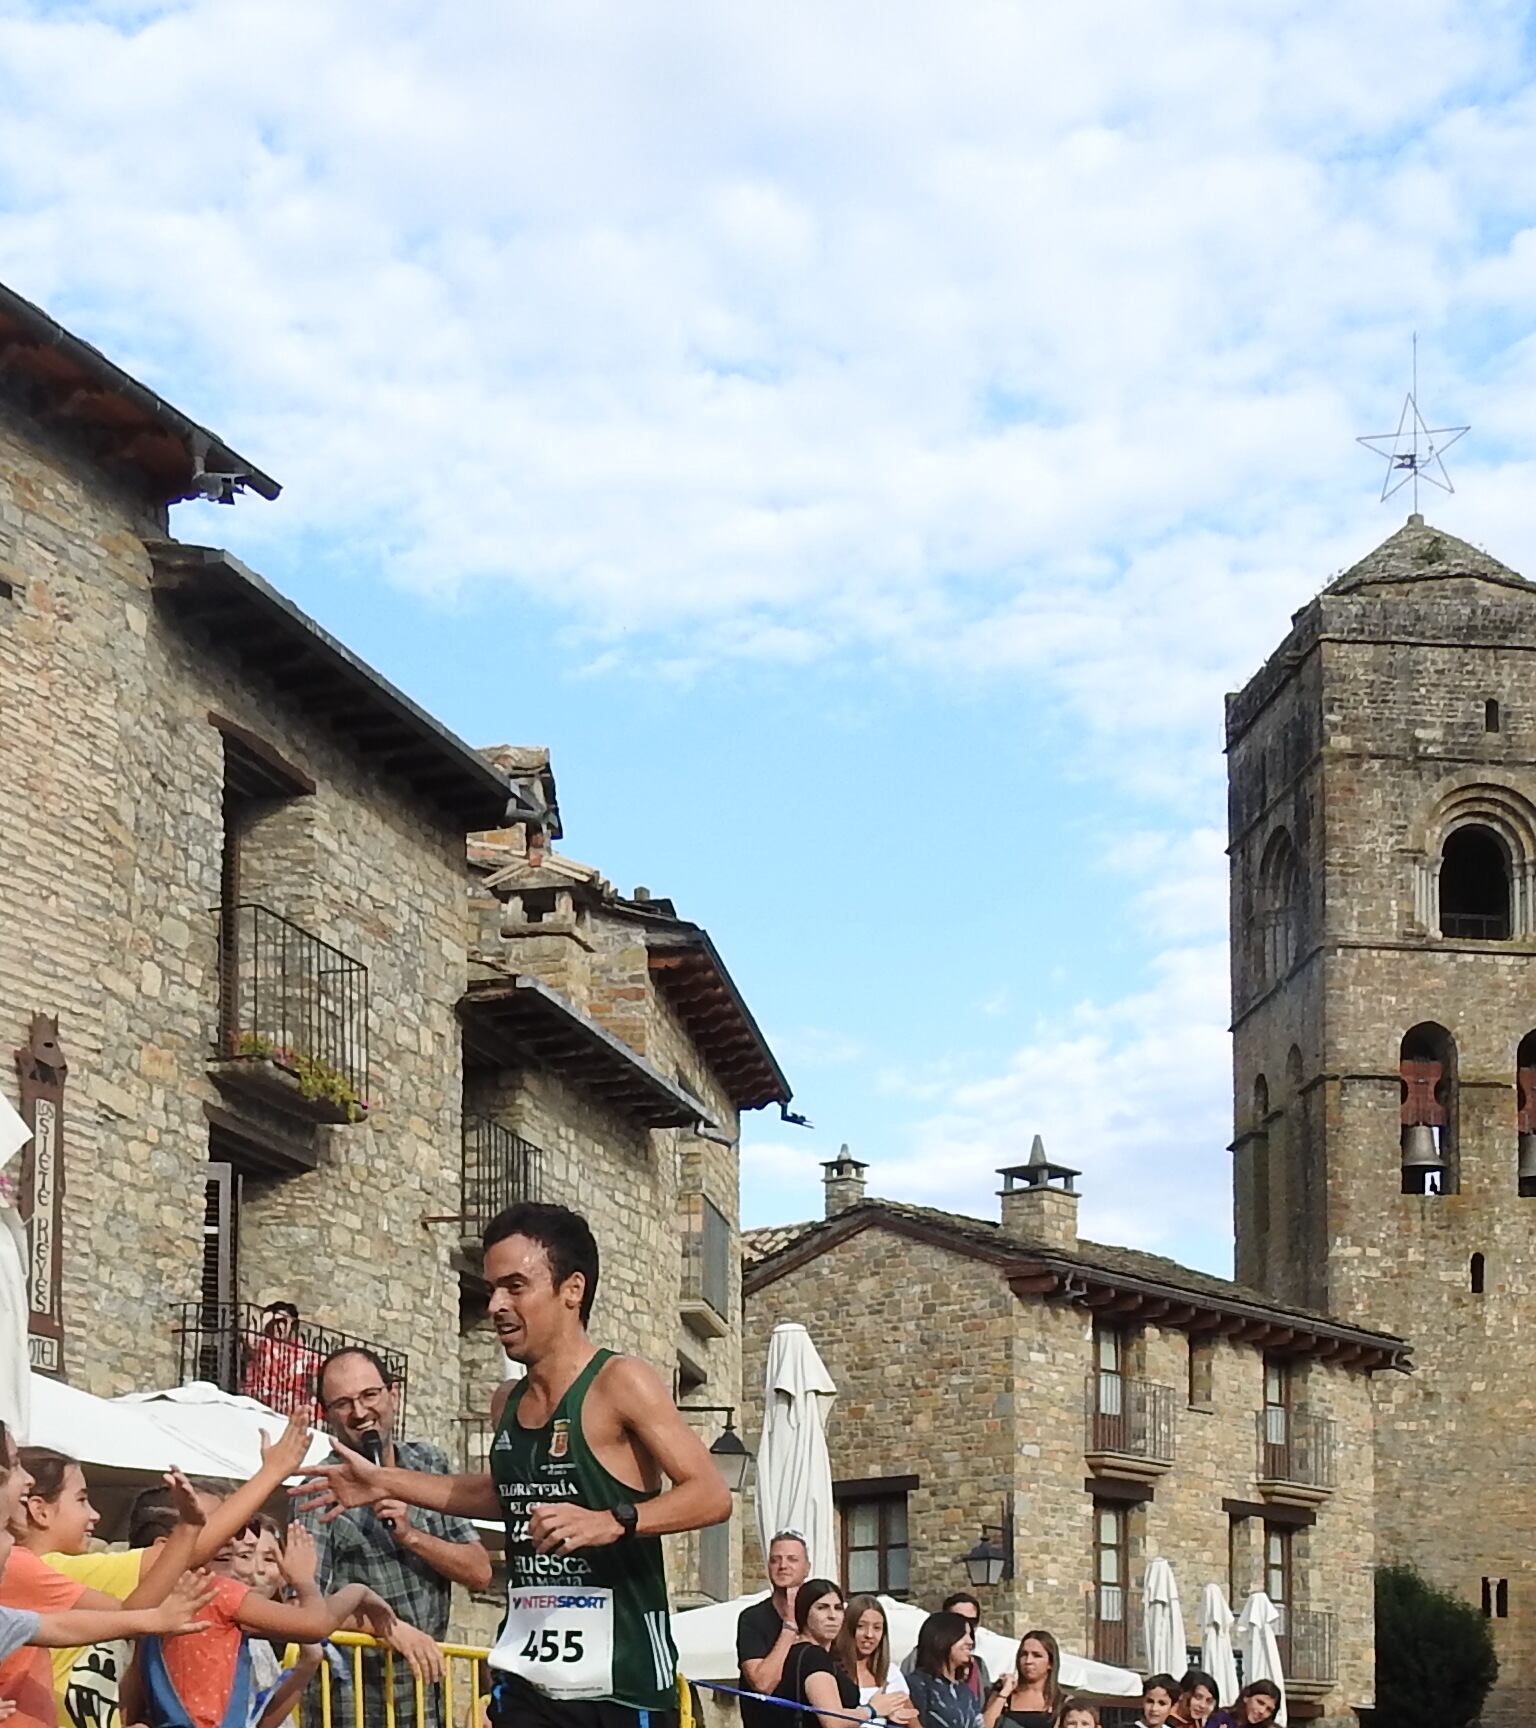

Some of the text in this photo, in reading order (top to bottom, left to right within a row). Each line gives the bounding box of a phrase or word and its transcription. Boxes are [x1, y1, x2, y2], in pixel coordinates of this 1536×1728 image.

[34, 1117, 51, 1313] SIETE REYES
[27, 1337, 55, 1367] OTEL
[519, 1629, 585, 1664] 455
